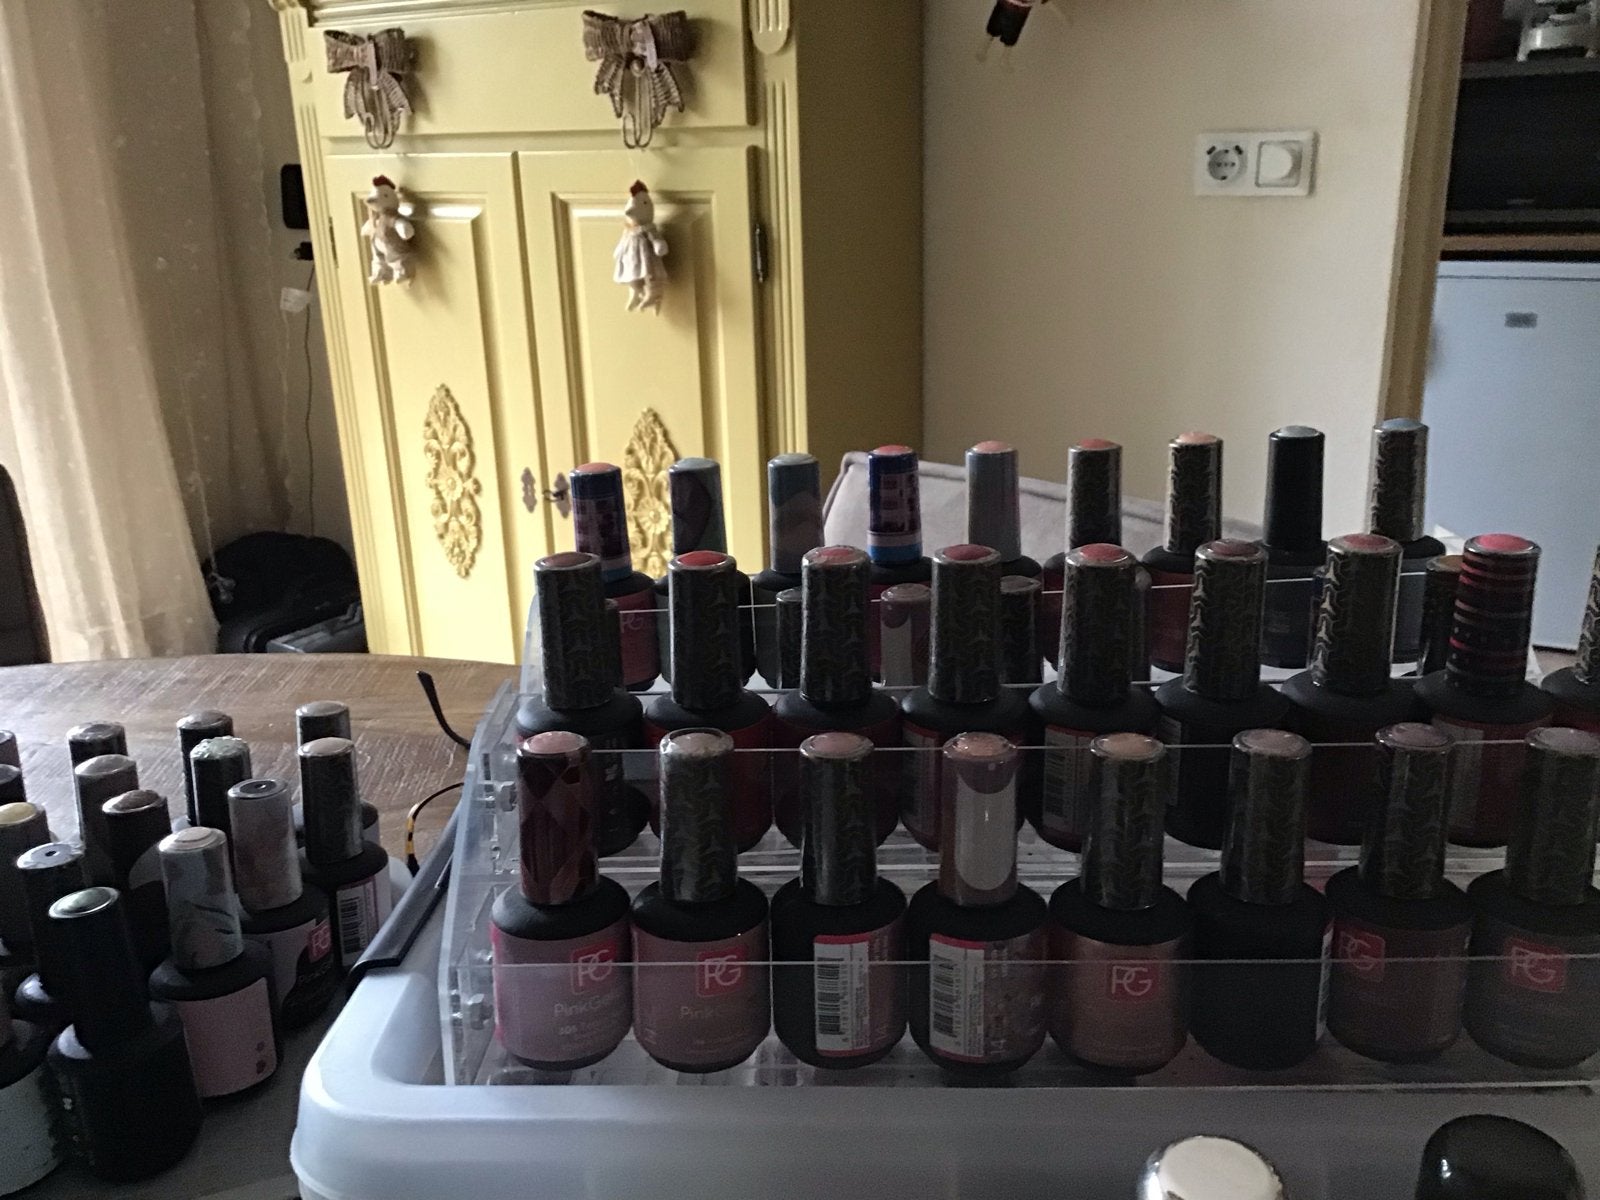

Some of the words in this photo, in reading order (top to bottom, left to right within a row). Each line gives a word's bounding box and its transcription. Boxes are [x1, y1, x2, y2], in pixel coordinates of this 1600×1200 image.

[577, 949, 613, 987] PG
[705, 954, 741, 989] PG
[1111, 965, 1152, 997] PG
[1511, 946, 1557, 984] PG
